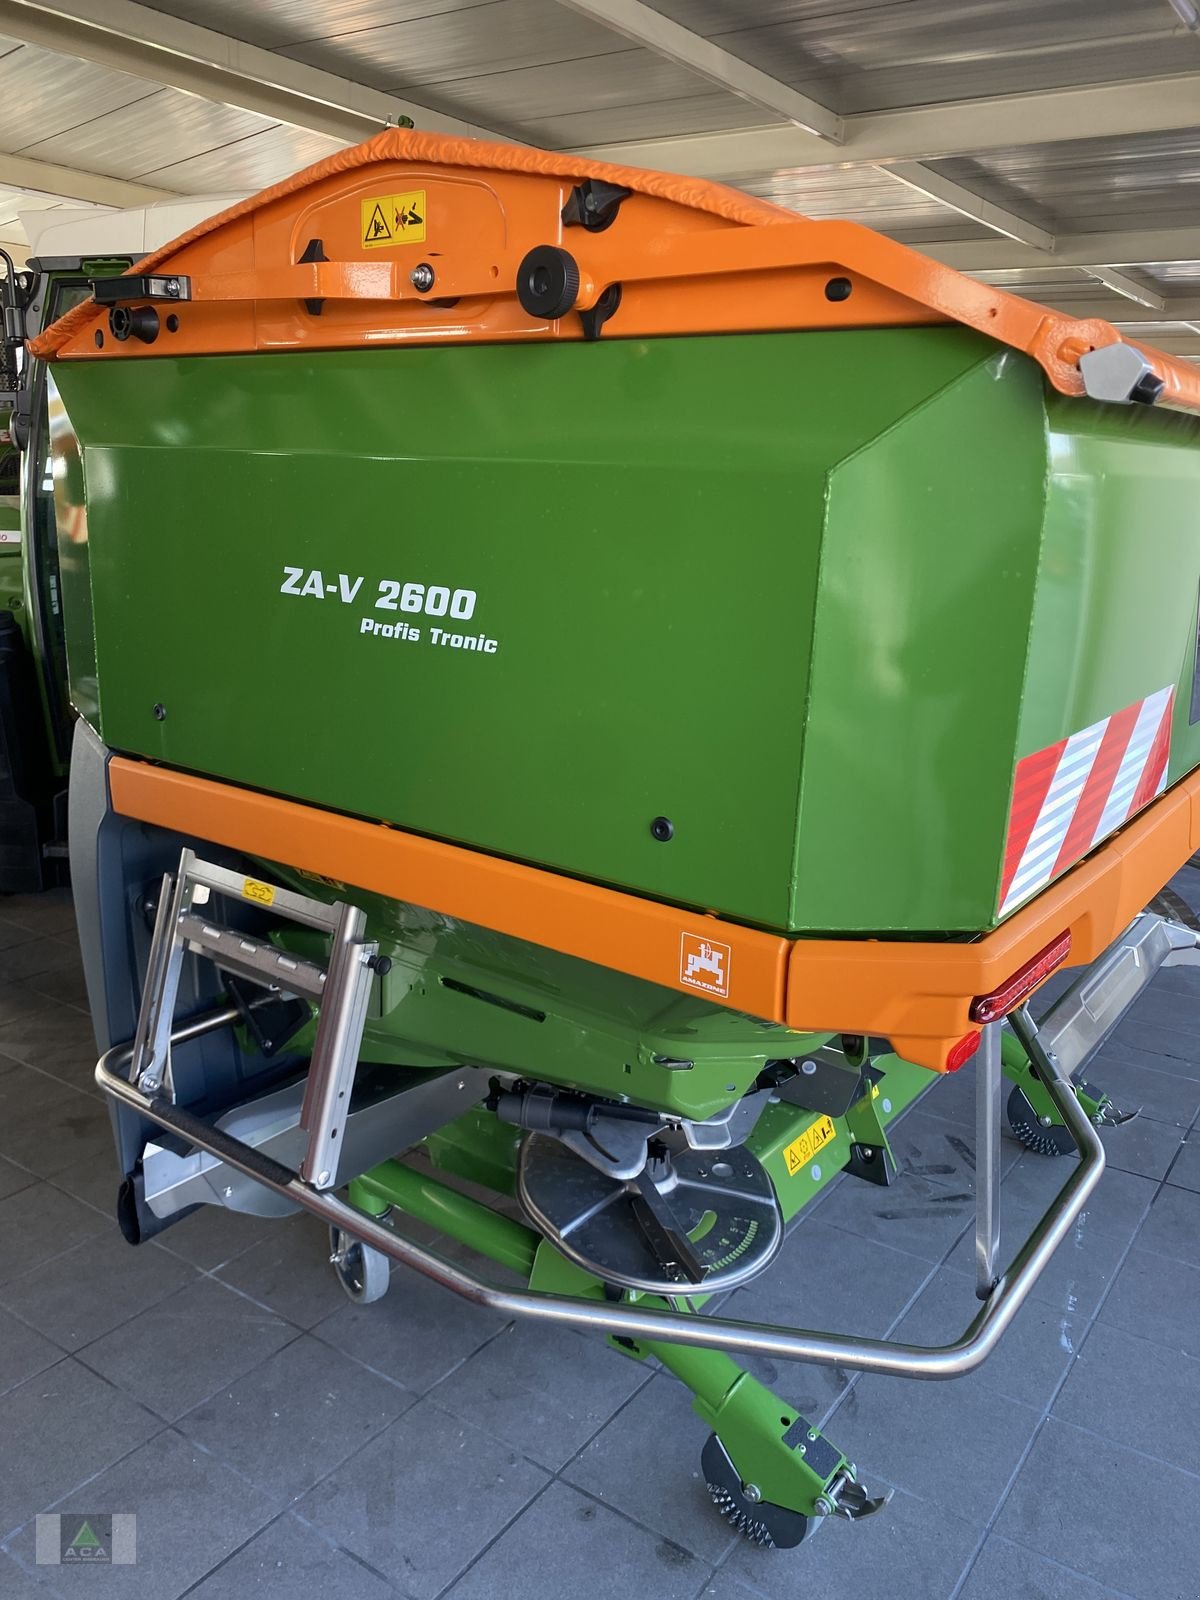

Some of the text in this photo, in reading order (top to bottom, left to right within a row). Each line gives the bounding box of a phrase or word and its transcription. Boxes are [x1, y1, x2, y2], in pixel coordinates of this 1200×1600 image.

[280, 566, 477, 620] ZA-V 2600
[360, 617, 498, 654] Profis Tronic
[682, 976, 727, 995] AMAZONE
